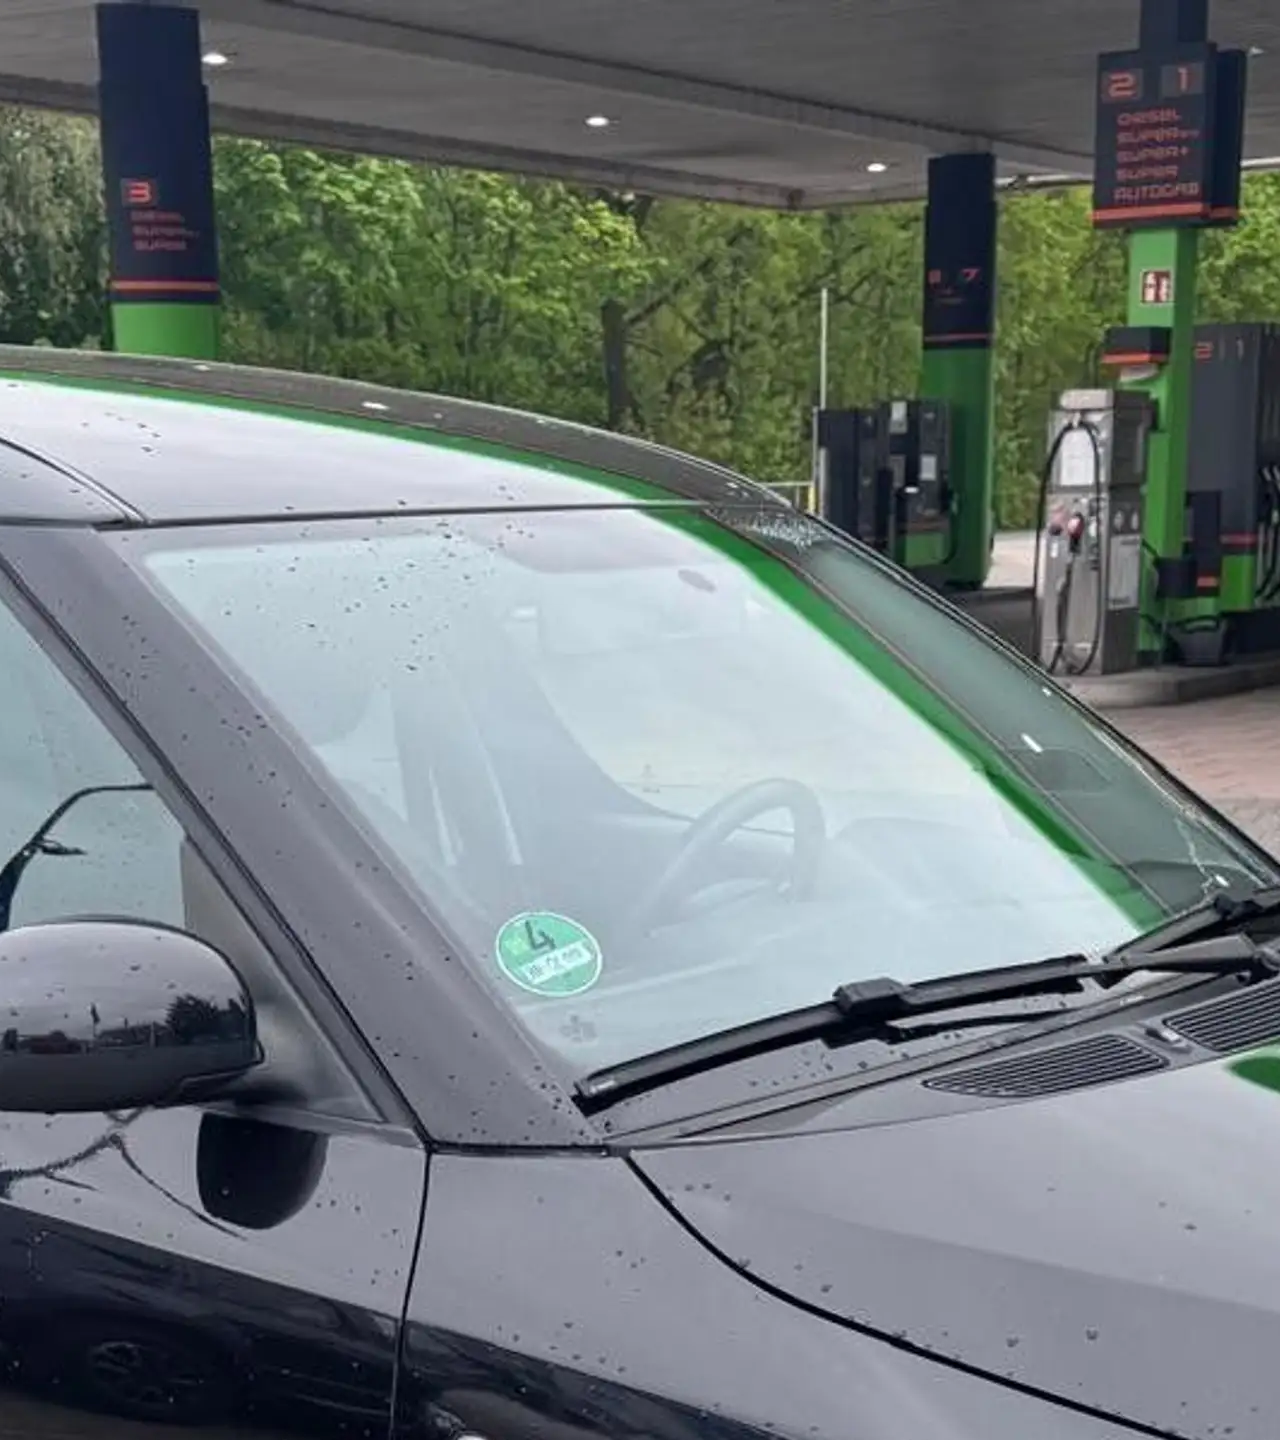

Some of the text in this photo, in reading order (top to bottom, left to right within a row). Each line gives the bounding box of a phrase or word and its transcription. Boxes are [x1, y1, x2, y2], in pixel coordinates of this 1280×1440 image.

[1108, 67, 1188, 98] 2 1
[128, 181, 152, 202] 3
[523, 919, 557, 950] 4
